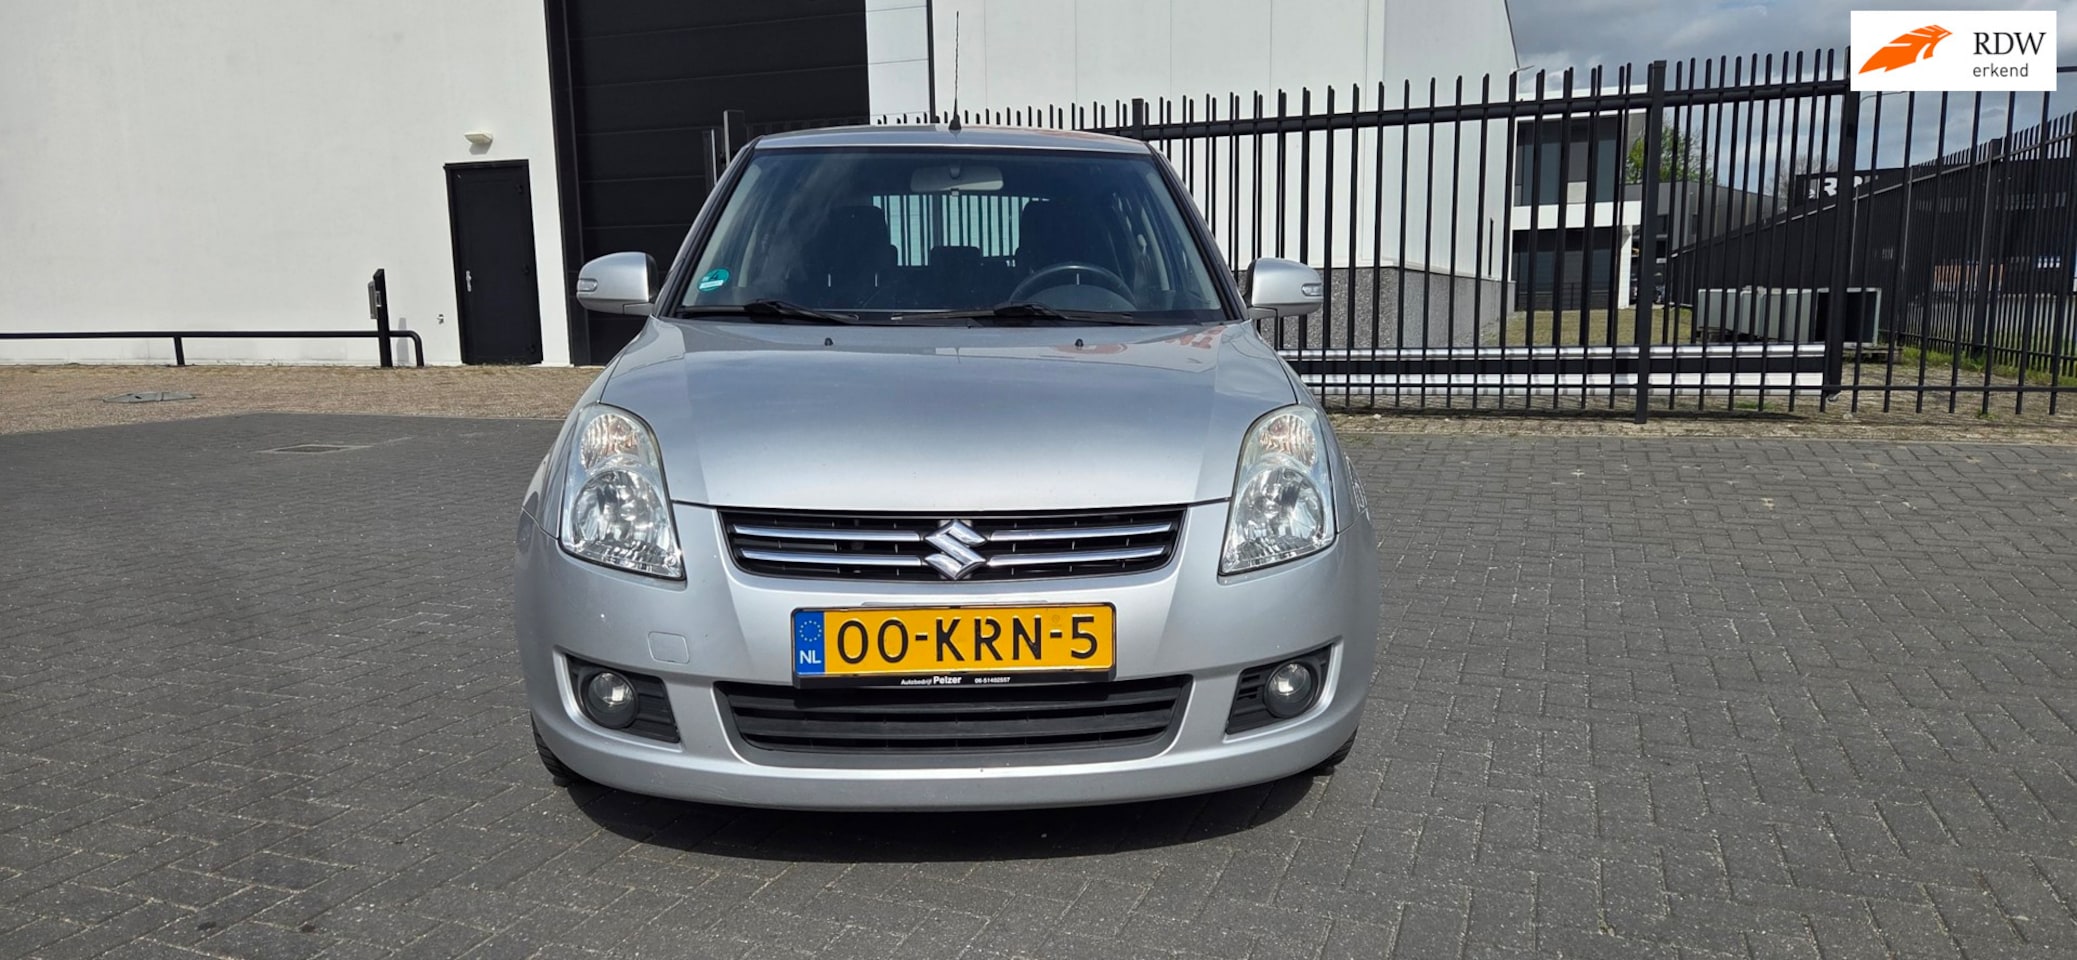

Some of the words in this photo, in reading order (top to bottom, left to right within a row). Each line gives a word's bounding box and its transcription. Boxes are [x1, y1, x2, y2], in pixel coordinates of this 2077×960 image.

[836, 615, 1099, 664] 00-KRN-5
[800, 649, 822, 665] NL
[933, 675, 962, 685] Pelzer
